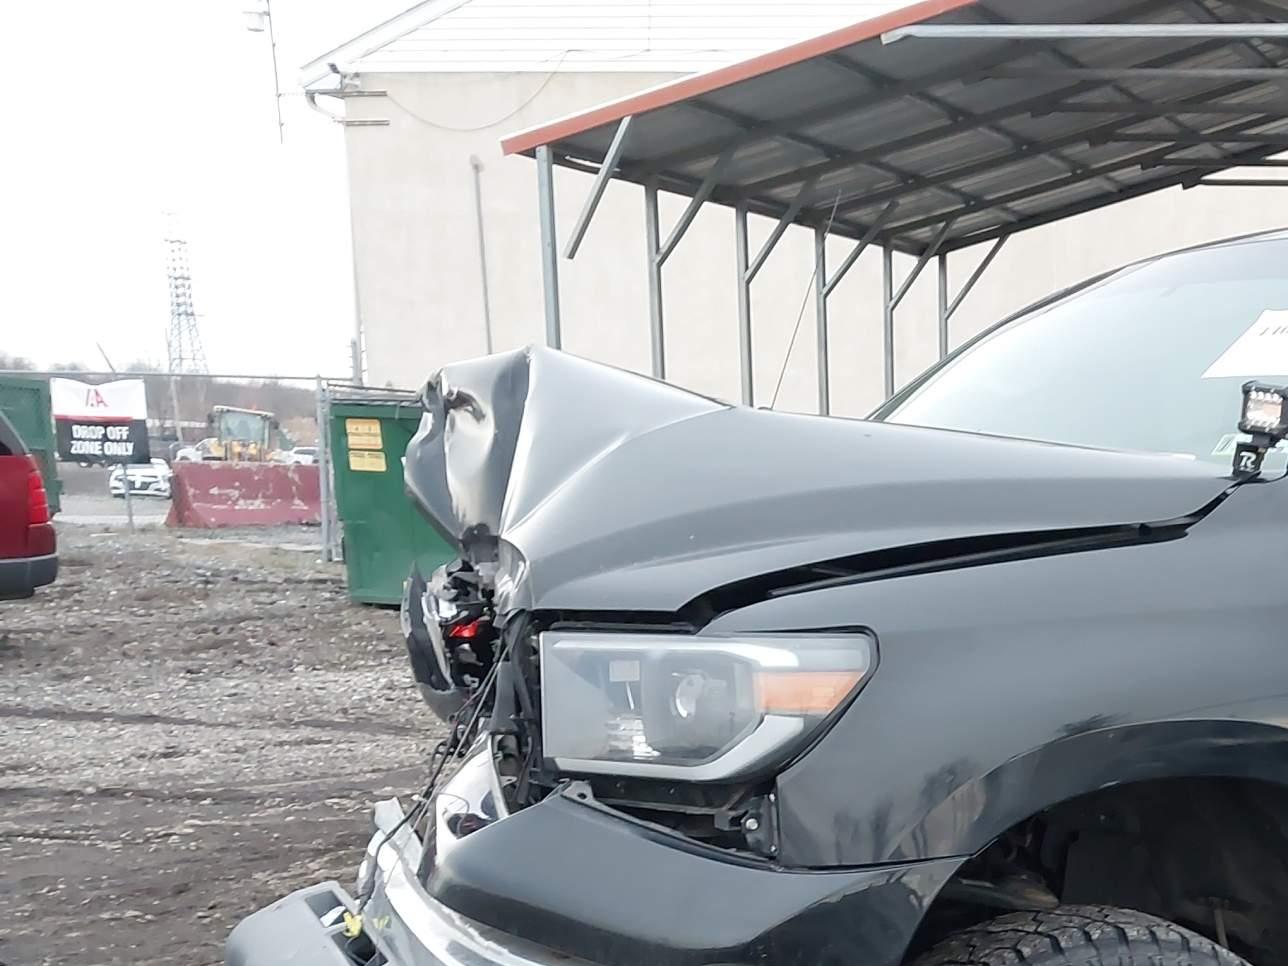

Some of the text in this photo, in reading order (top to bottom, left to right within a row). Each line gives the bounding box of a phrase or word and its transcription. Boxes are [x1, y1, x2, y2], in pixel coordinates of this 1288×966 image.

[71, 424, 129, 440] DROP OFF
[70, 440, 134, 456] ZONE ONLY
